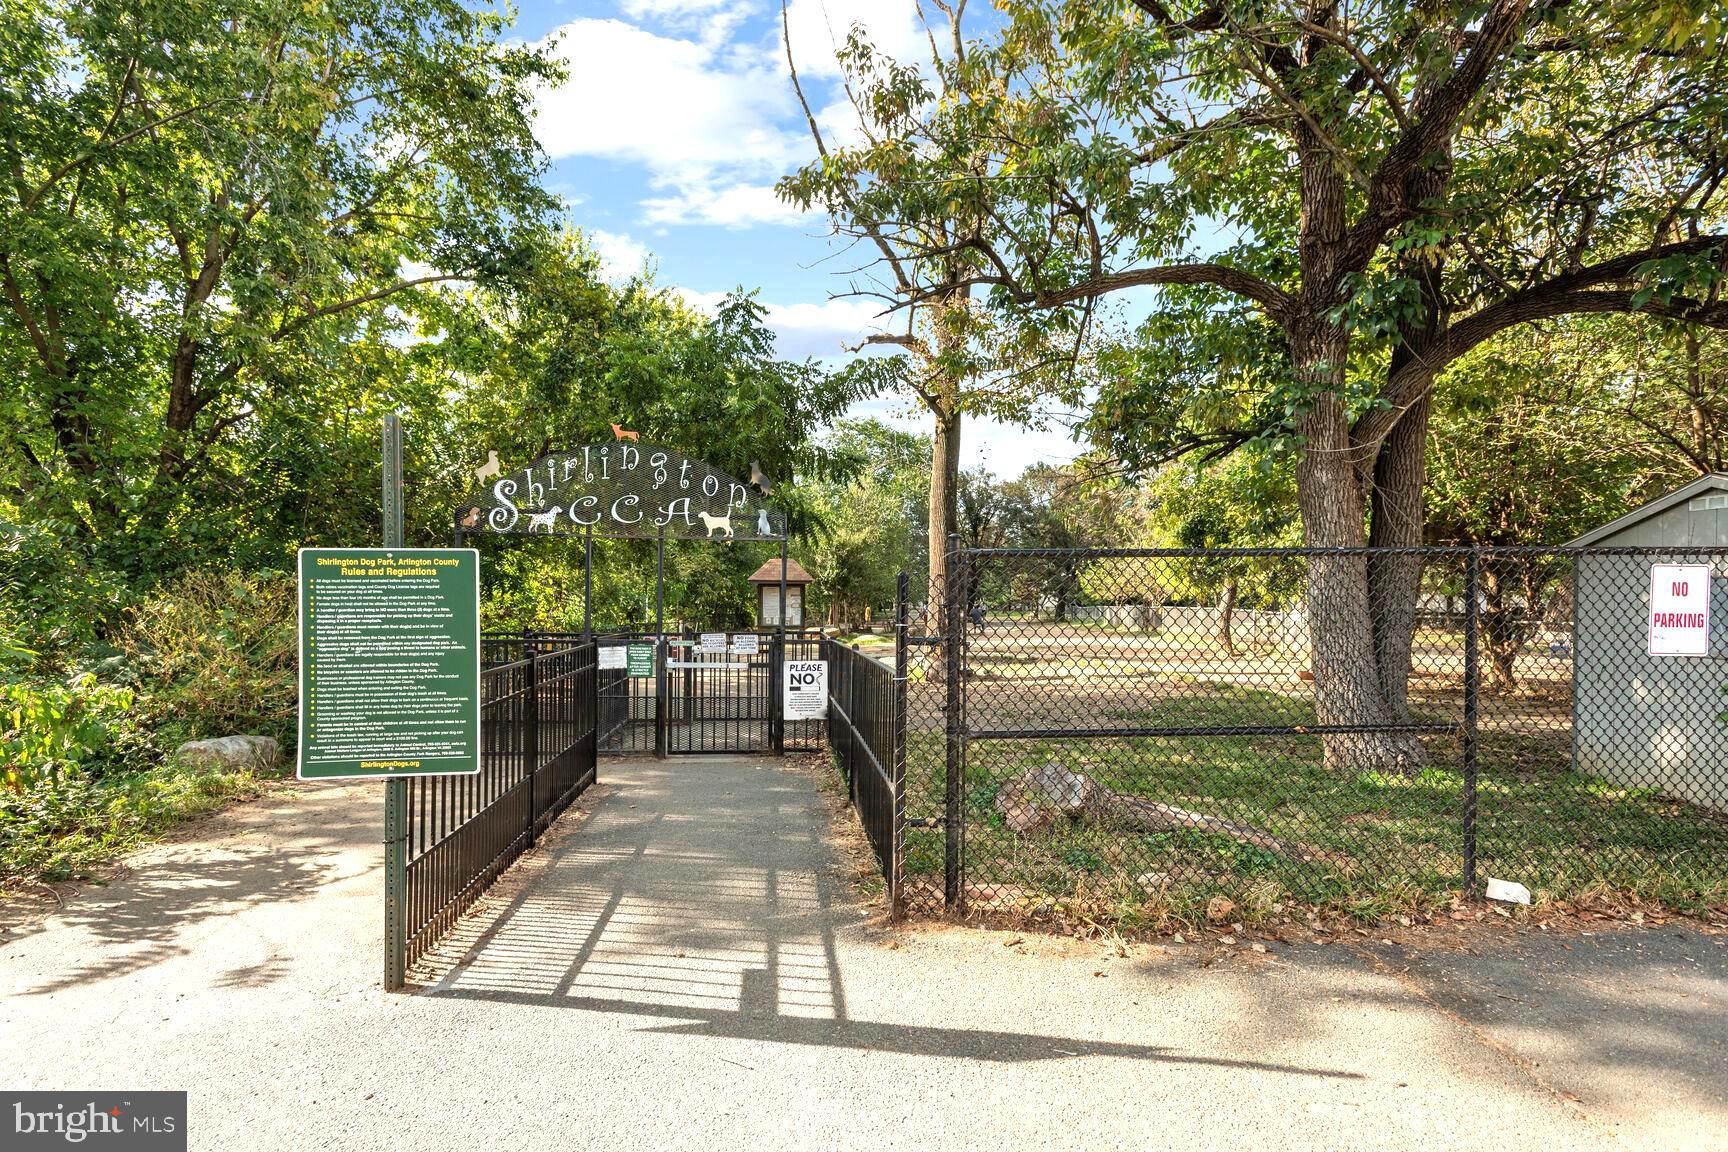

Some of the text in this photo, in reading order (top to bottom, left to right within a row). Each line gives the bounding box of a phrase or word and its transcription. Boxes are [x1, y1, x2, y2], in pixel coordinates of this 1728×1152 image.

[489, 445, 747, 531] Shirlington
[317, 558, 460, 567] Shirlington Dog Park, Arlington County
[341, 567, 437, 578] Rules and Regulations
[1671, 581, 1689, 597] NO
[1653, 612, 1705, 628] PARKING
[789, 663, 823, 672] PLEASE
[790, 673, 815, 685] NO
[360, 760, 420, 769] ShirlingtonDogs.org
